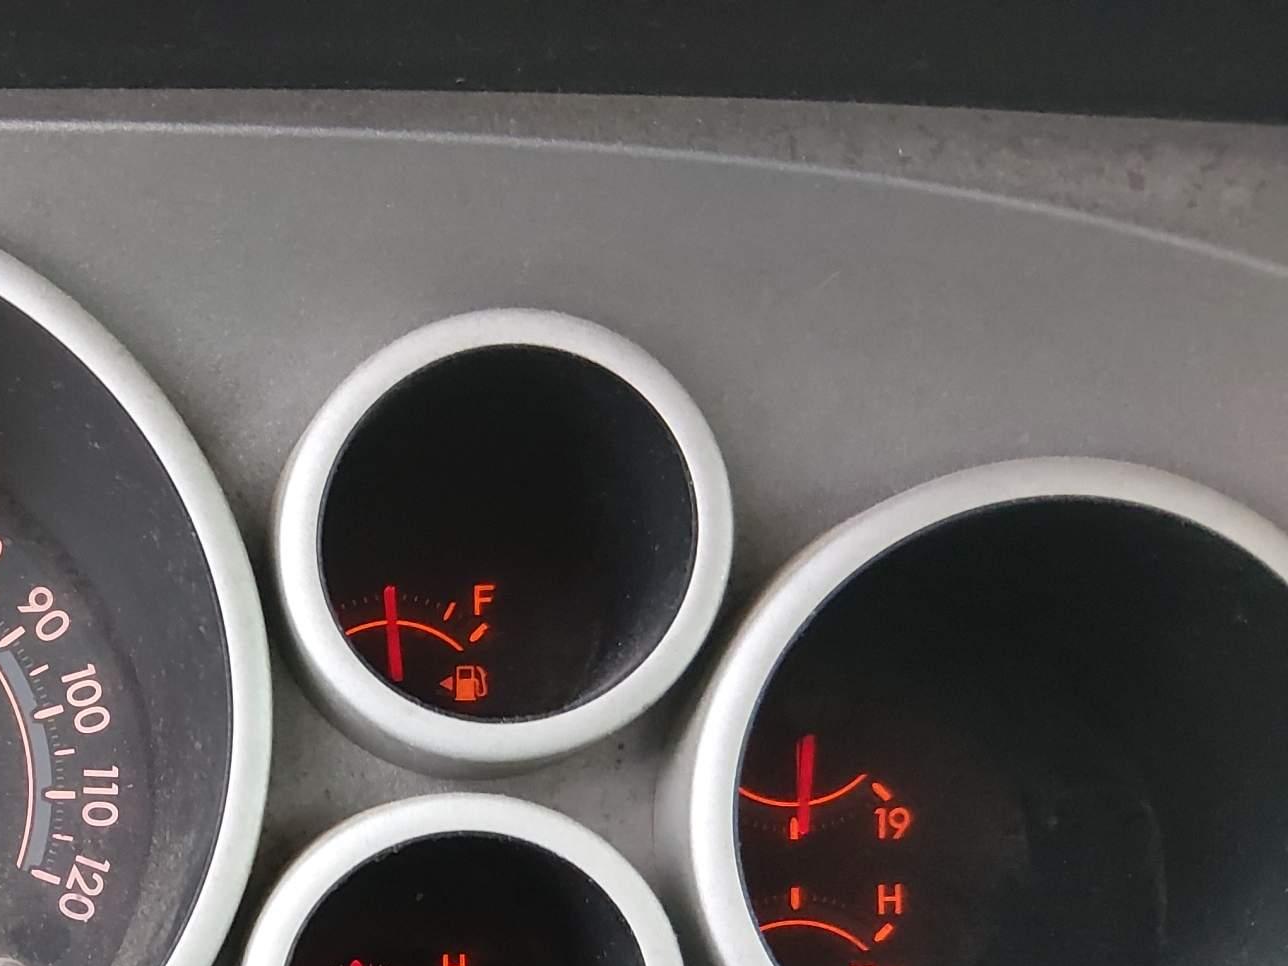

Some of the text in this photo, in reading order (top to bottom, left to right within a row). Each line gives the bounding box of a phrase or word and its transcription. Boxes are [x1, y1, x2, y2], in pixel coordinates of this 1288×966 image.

[16, 586, 70, 642] 90
[473, 584, 495, 616] F
[60, 663, 111, 734] 100
[81, 765, 119, 827] 110
[874, 806, 911, 840] 19
[57, 855, 110, 923] 120
[877, 883, 903, 915] H
